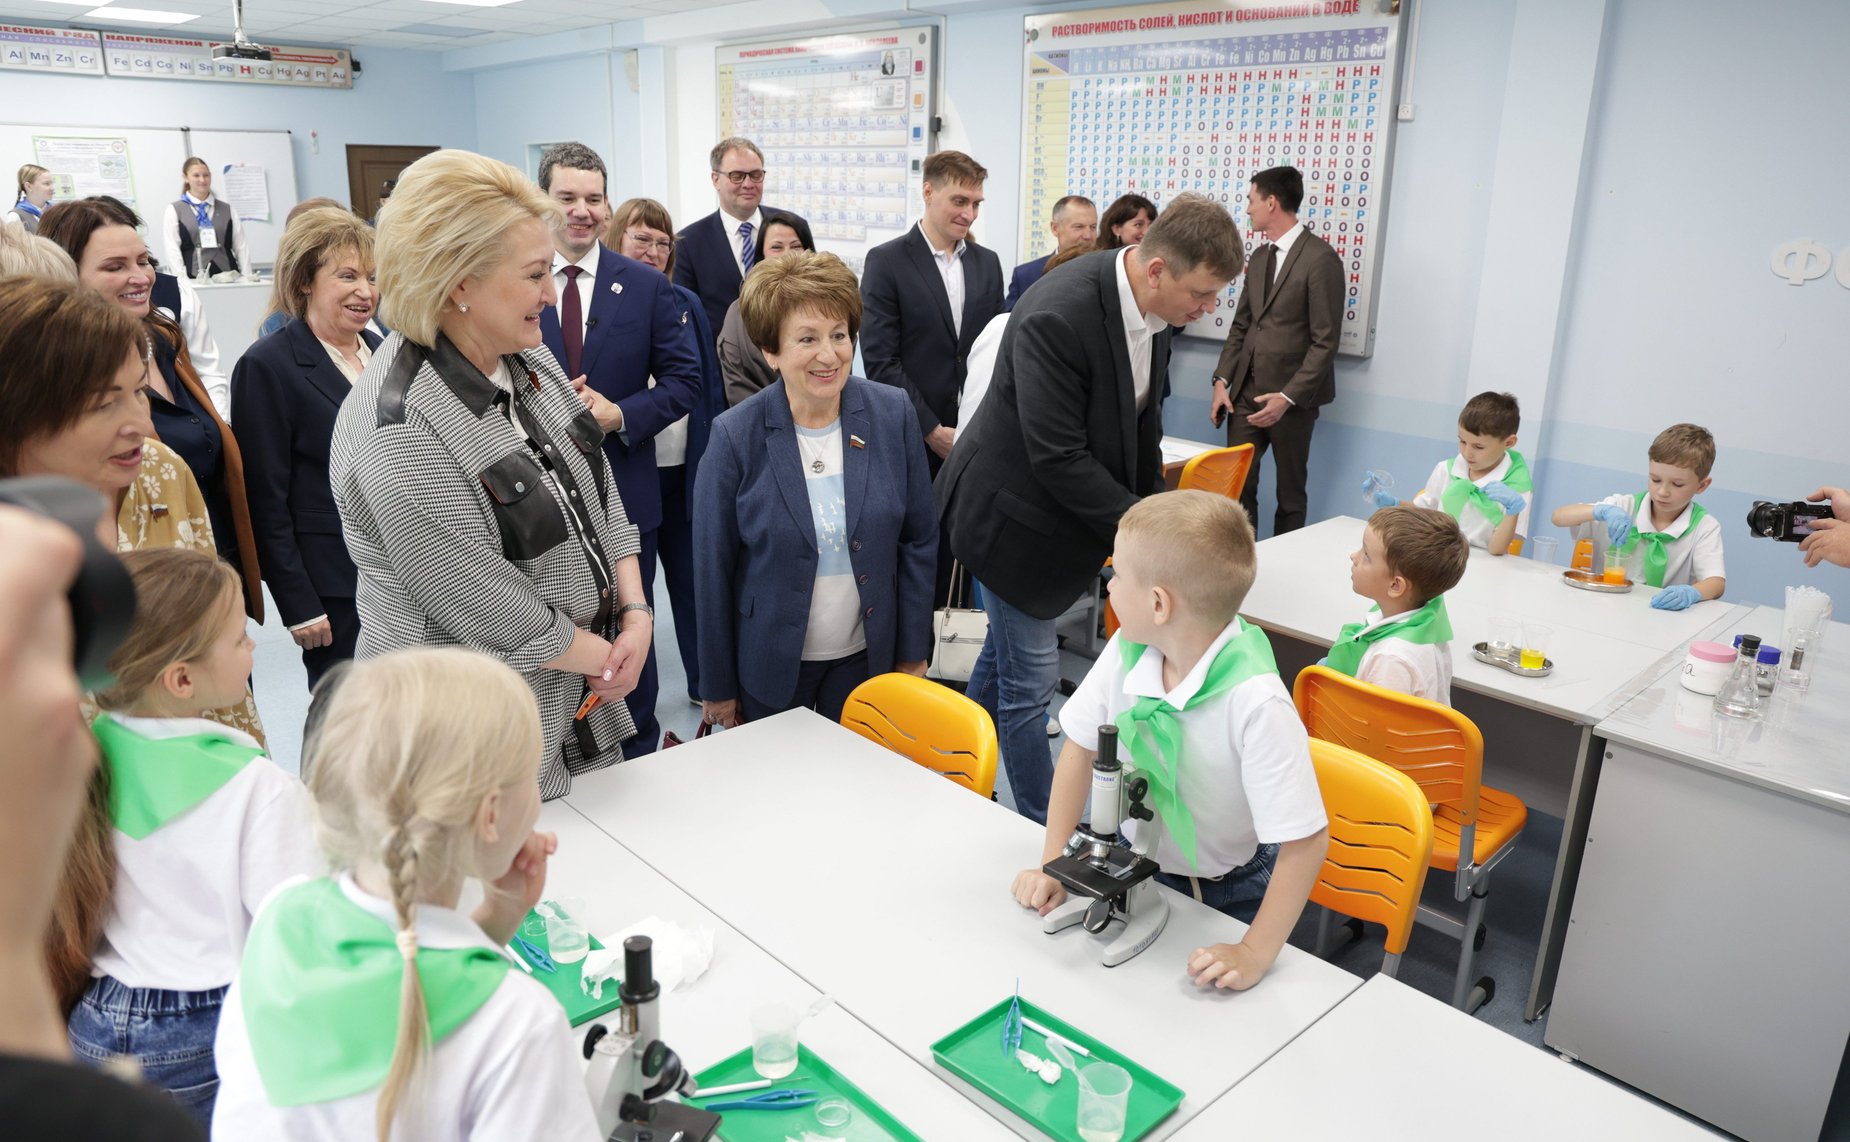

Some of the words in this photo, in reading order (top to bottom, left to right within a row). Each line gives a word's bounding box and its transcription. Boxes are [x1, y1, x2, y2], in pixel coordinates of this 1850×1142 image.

[1052, 20, 1136, 38] РАСТВОРИМОСТЬ
[1139, 13, 1177, 30] СОЛЕЙ,
[1178, 11, 1223, 27] КИСЛОТ
[1225, 10, 1232, 22] И
[1236, 4, 1308, 22] ОСНОВАНИЙ
[1312, 3, 1321, 15] В
[1324, 0, 1360, 14] ВОДЕ
[105, 34, 203, 47] НАПРЯЖЕНИЙ
[9, 50, 24, 59] Al
[30, 52, 49, 61] Mn
[56, 53, 73, 62] Zn
[80, 55, 95, 64] Cr
[114, 57, 128, 66] Fe
[135, 59, 151, 67] Cd
[156, 60, 173, 69] Co
[179, 62, 191, 70] Ni
[199, 63, 214, 71] Sn
[219, 64, 233, 73] Pb
[240, 65, 251, 75] H
[258, 67, 273, 76] Cu
[277, 67, 291, 78] Hg
[296, 68, 310, 79] Ag
[316, 70, 326, 78] Pt
[332, 71, 346, 80] Au
